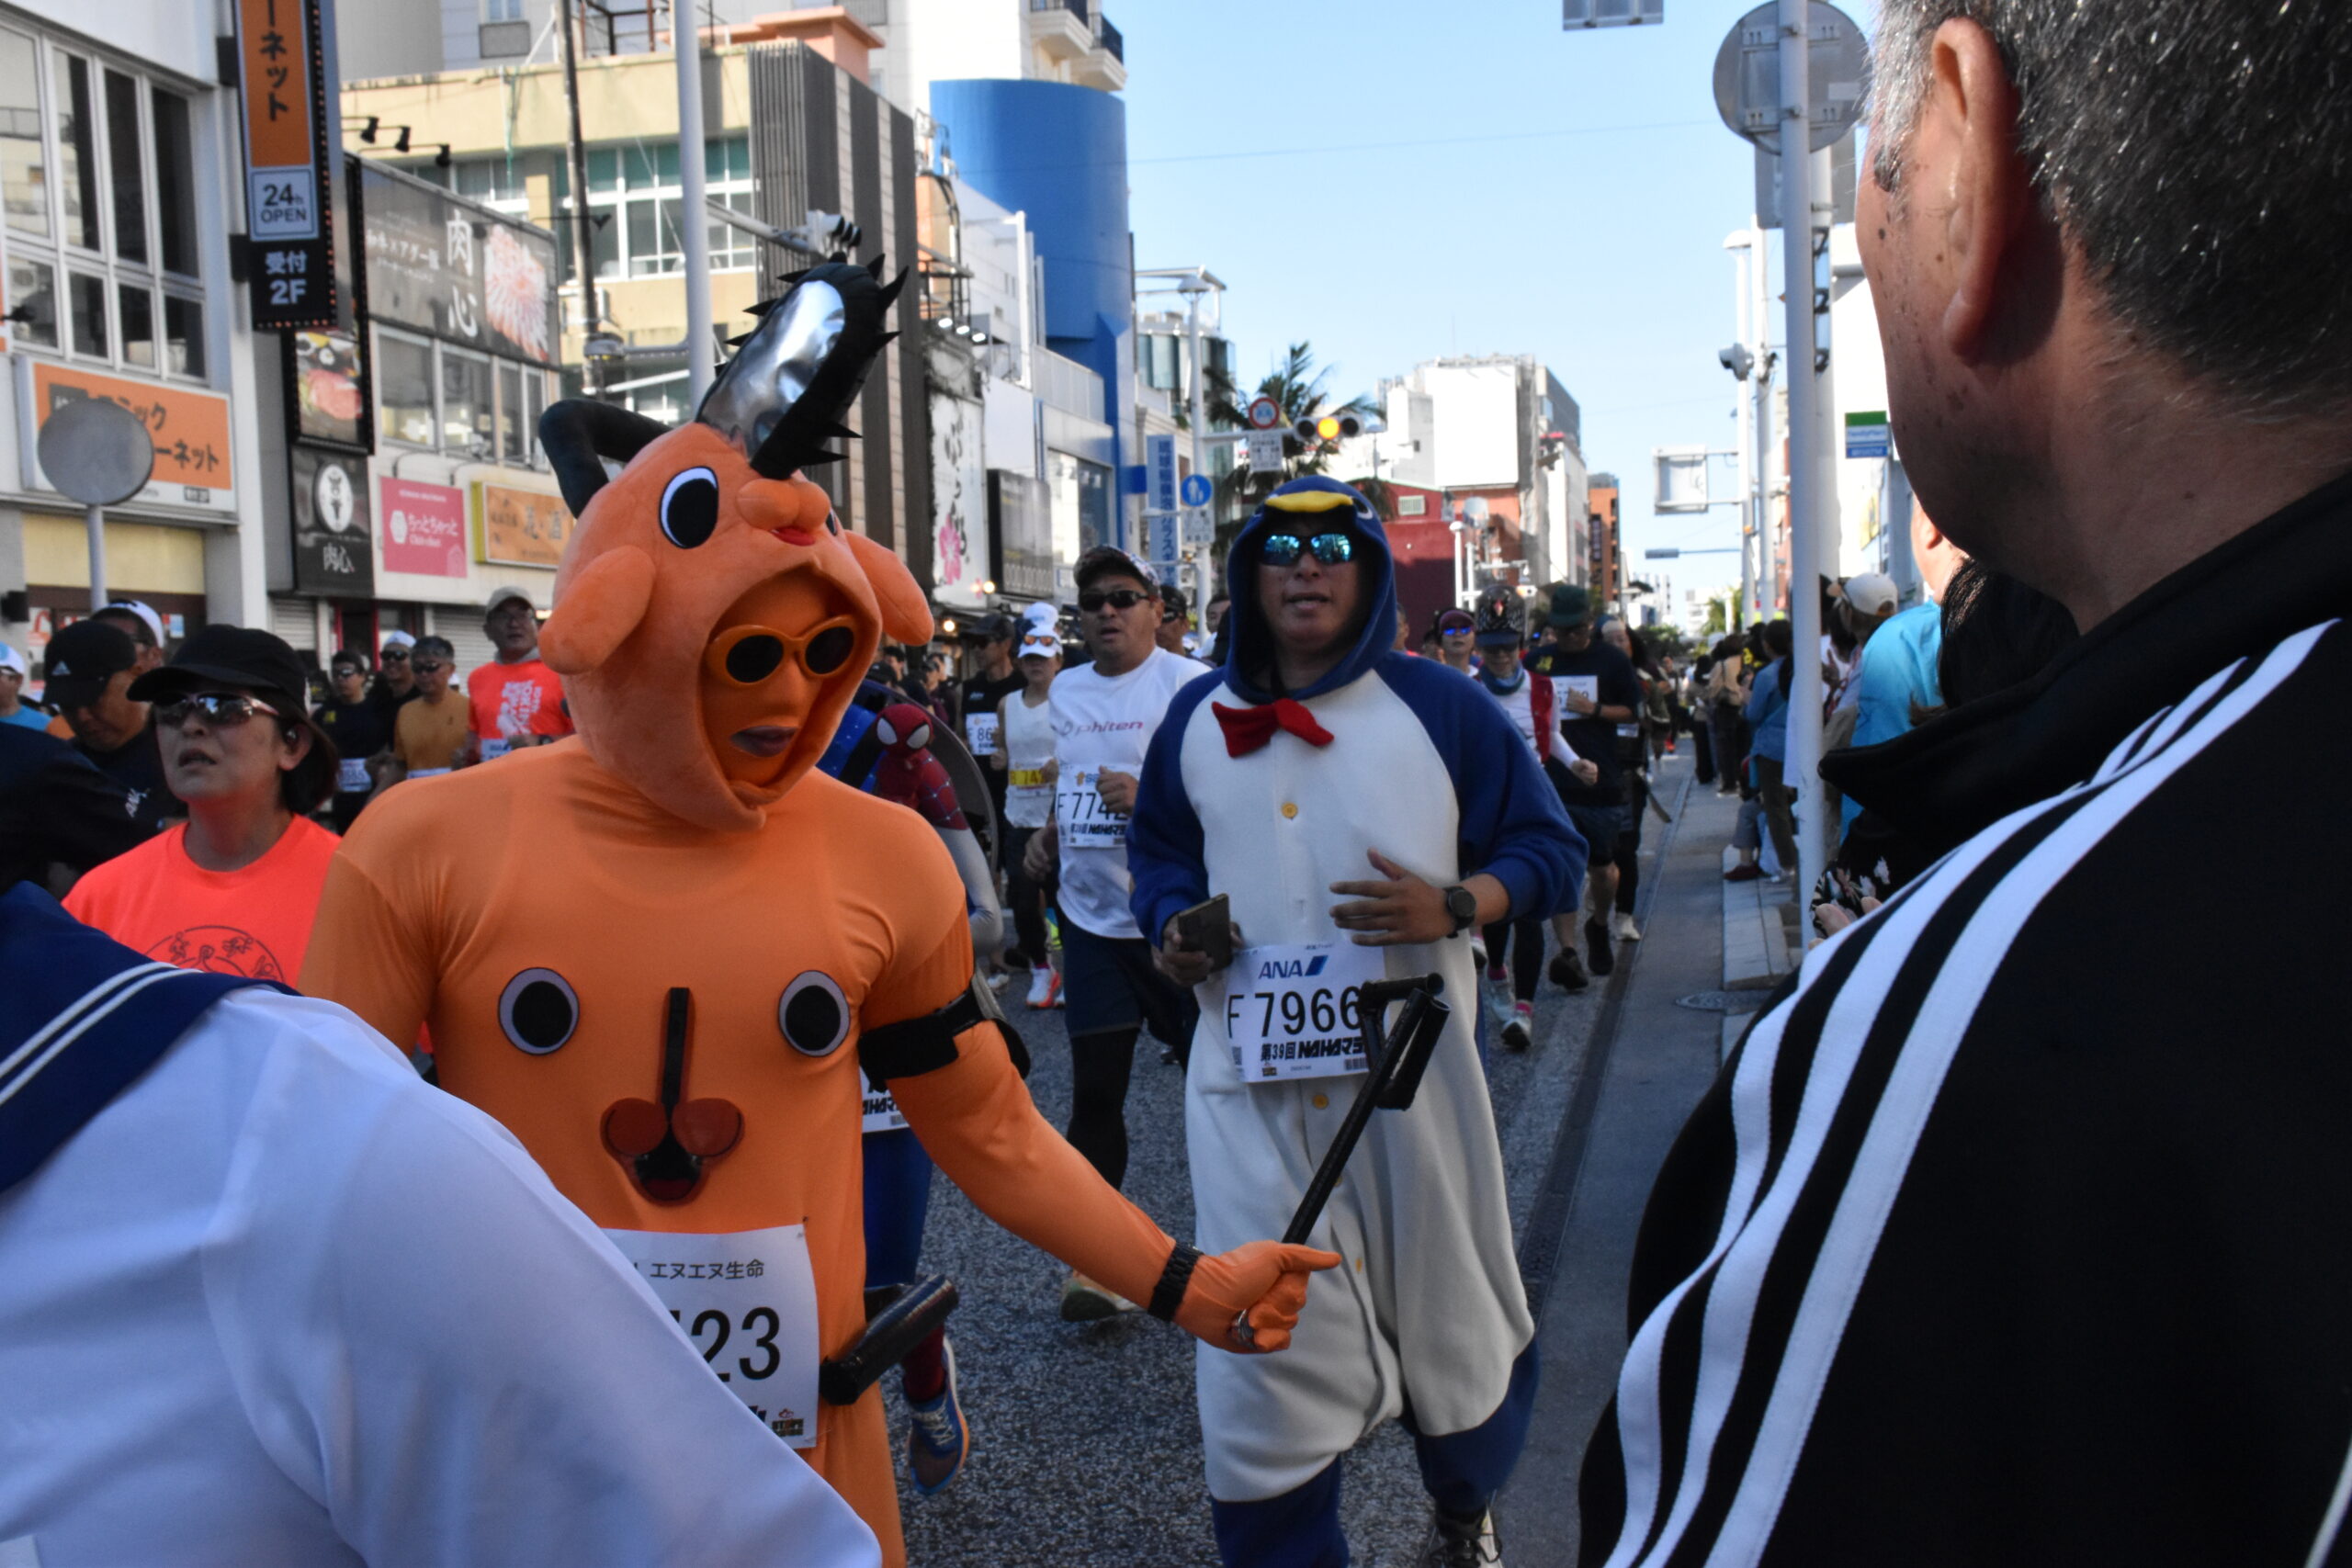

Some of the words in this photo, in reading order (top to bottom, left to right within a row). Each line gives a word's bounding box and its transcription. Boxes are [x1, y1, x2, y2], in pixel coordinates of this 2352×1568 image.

[261, 208, 307, 223] OPEN
[265, 250, 307, 275] 受付
[269, 278, 307, 305] 2F
[1259, 960, 1303, 979] ANA
[1227, 994, 1245, 1039] F
[1254, 986, 1363, 1037] 7966
[650, 1258, 765, 1280] エヌエヌ生命
